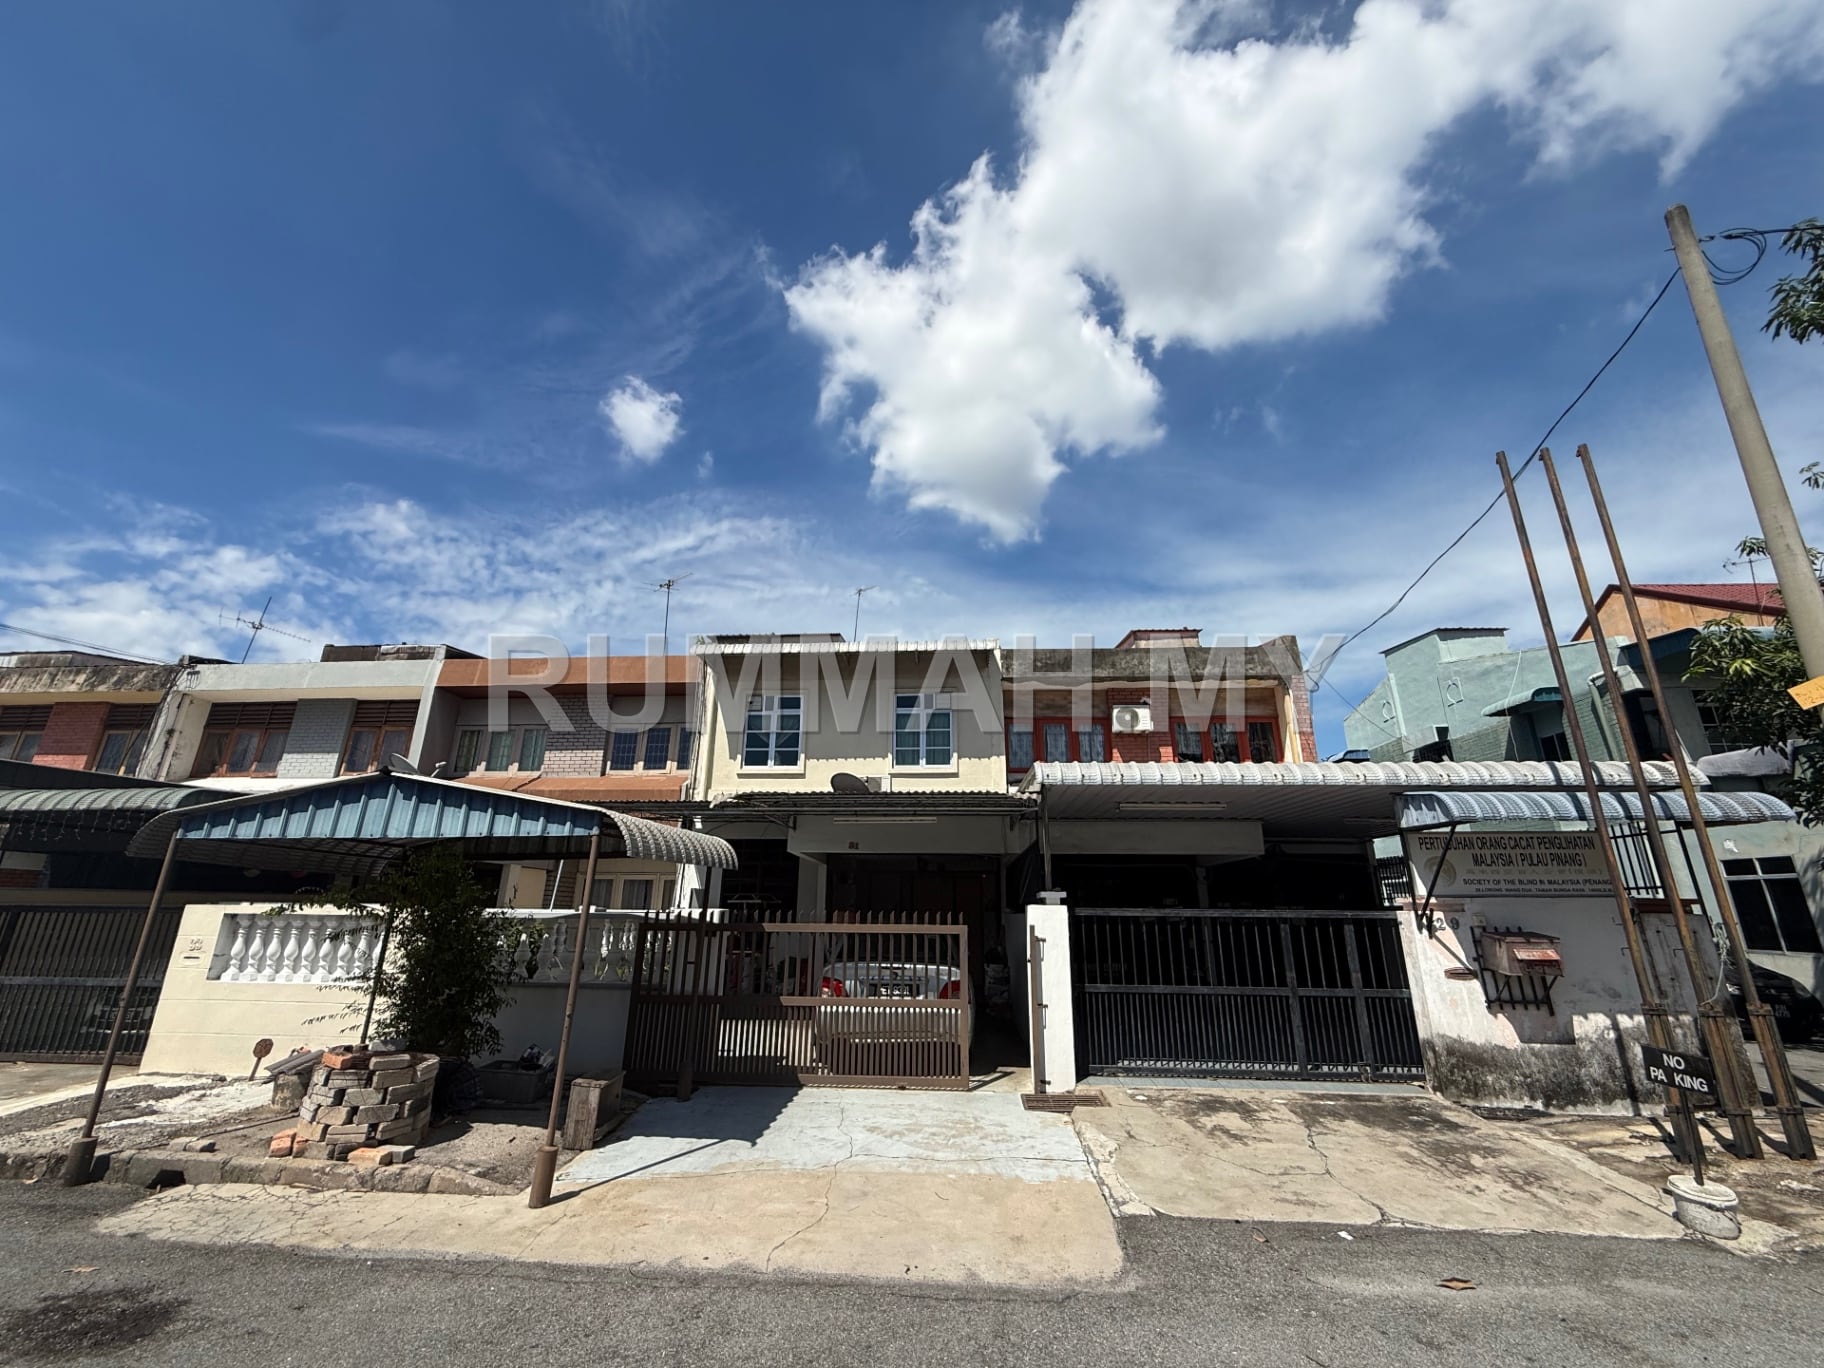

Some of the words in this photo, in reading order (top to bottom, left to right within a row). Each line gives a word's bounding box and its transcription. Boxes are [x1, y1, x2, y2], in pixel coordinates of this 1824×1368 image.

[1476, 836, 1507, 850] ORANG
[1508, 836, 1535, 850] CACAT
[1537, 836, 1596, 850] PENGLIHATAN
[1472, 852, 1513, 867] MALAYSIA
[1518, 878, 1538, 886] BLIND
[1436, 916, 1459, 931] 29
[1662, 1053, 1685, 1070] NO
